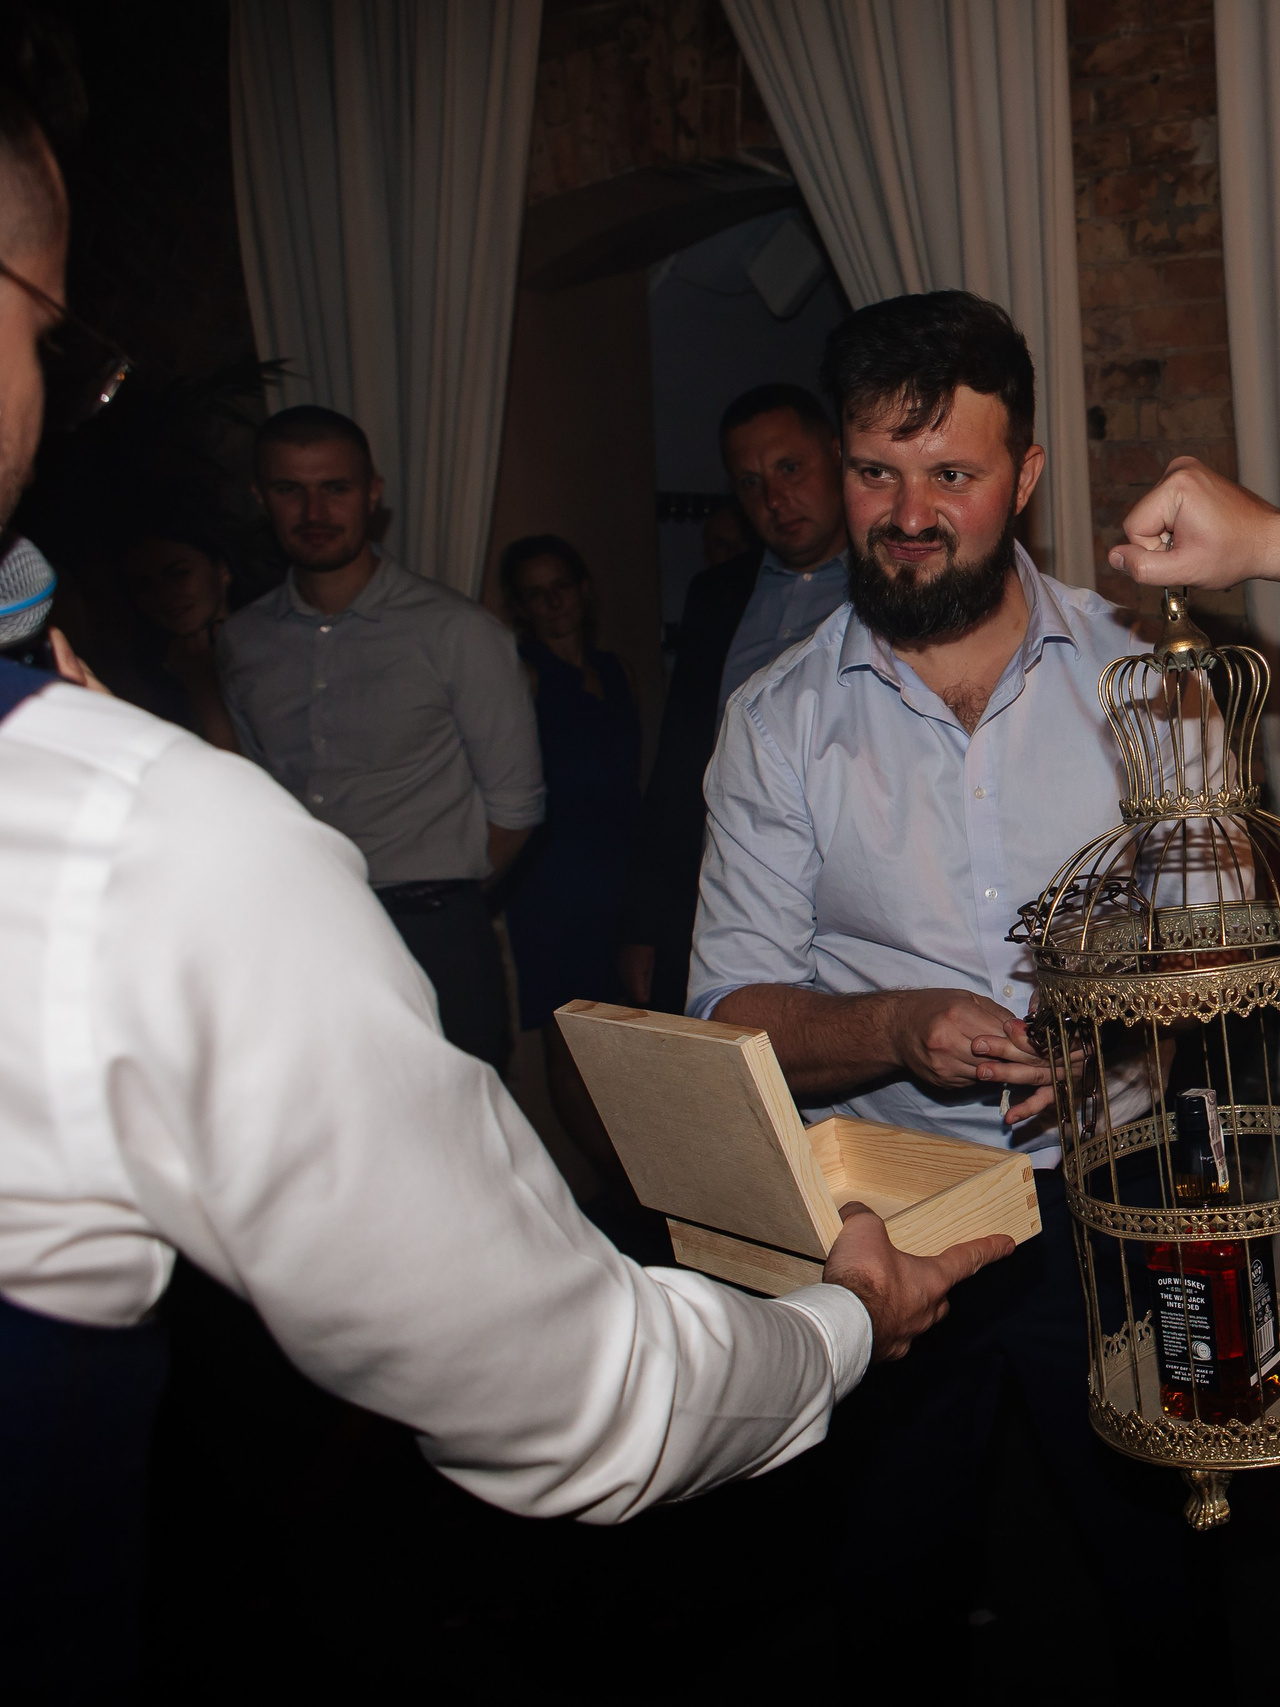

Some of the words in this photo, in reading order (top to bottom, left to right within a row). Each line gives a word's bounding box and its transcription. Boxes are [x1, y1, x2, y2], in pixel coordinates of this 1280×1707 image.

[1158, 1278, 1173, 1286] OUR
[1160, 1292, 1173, 1300] THE
[1173, 1294, 1188, 1302] WA
[1187, 1296, 1206, 1304] JACK
